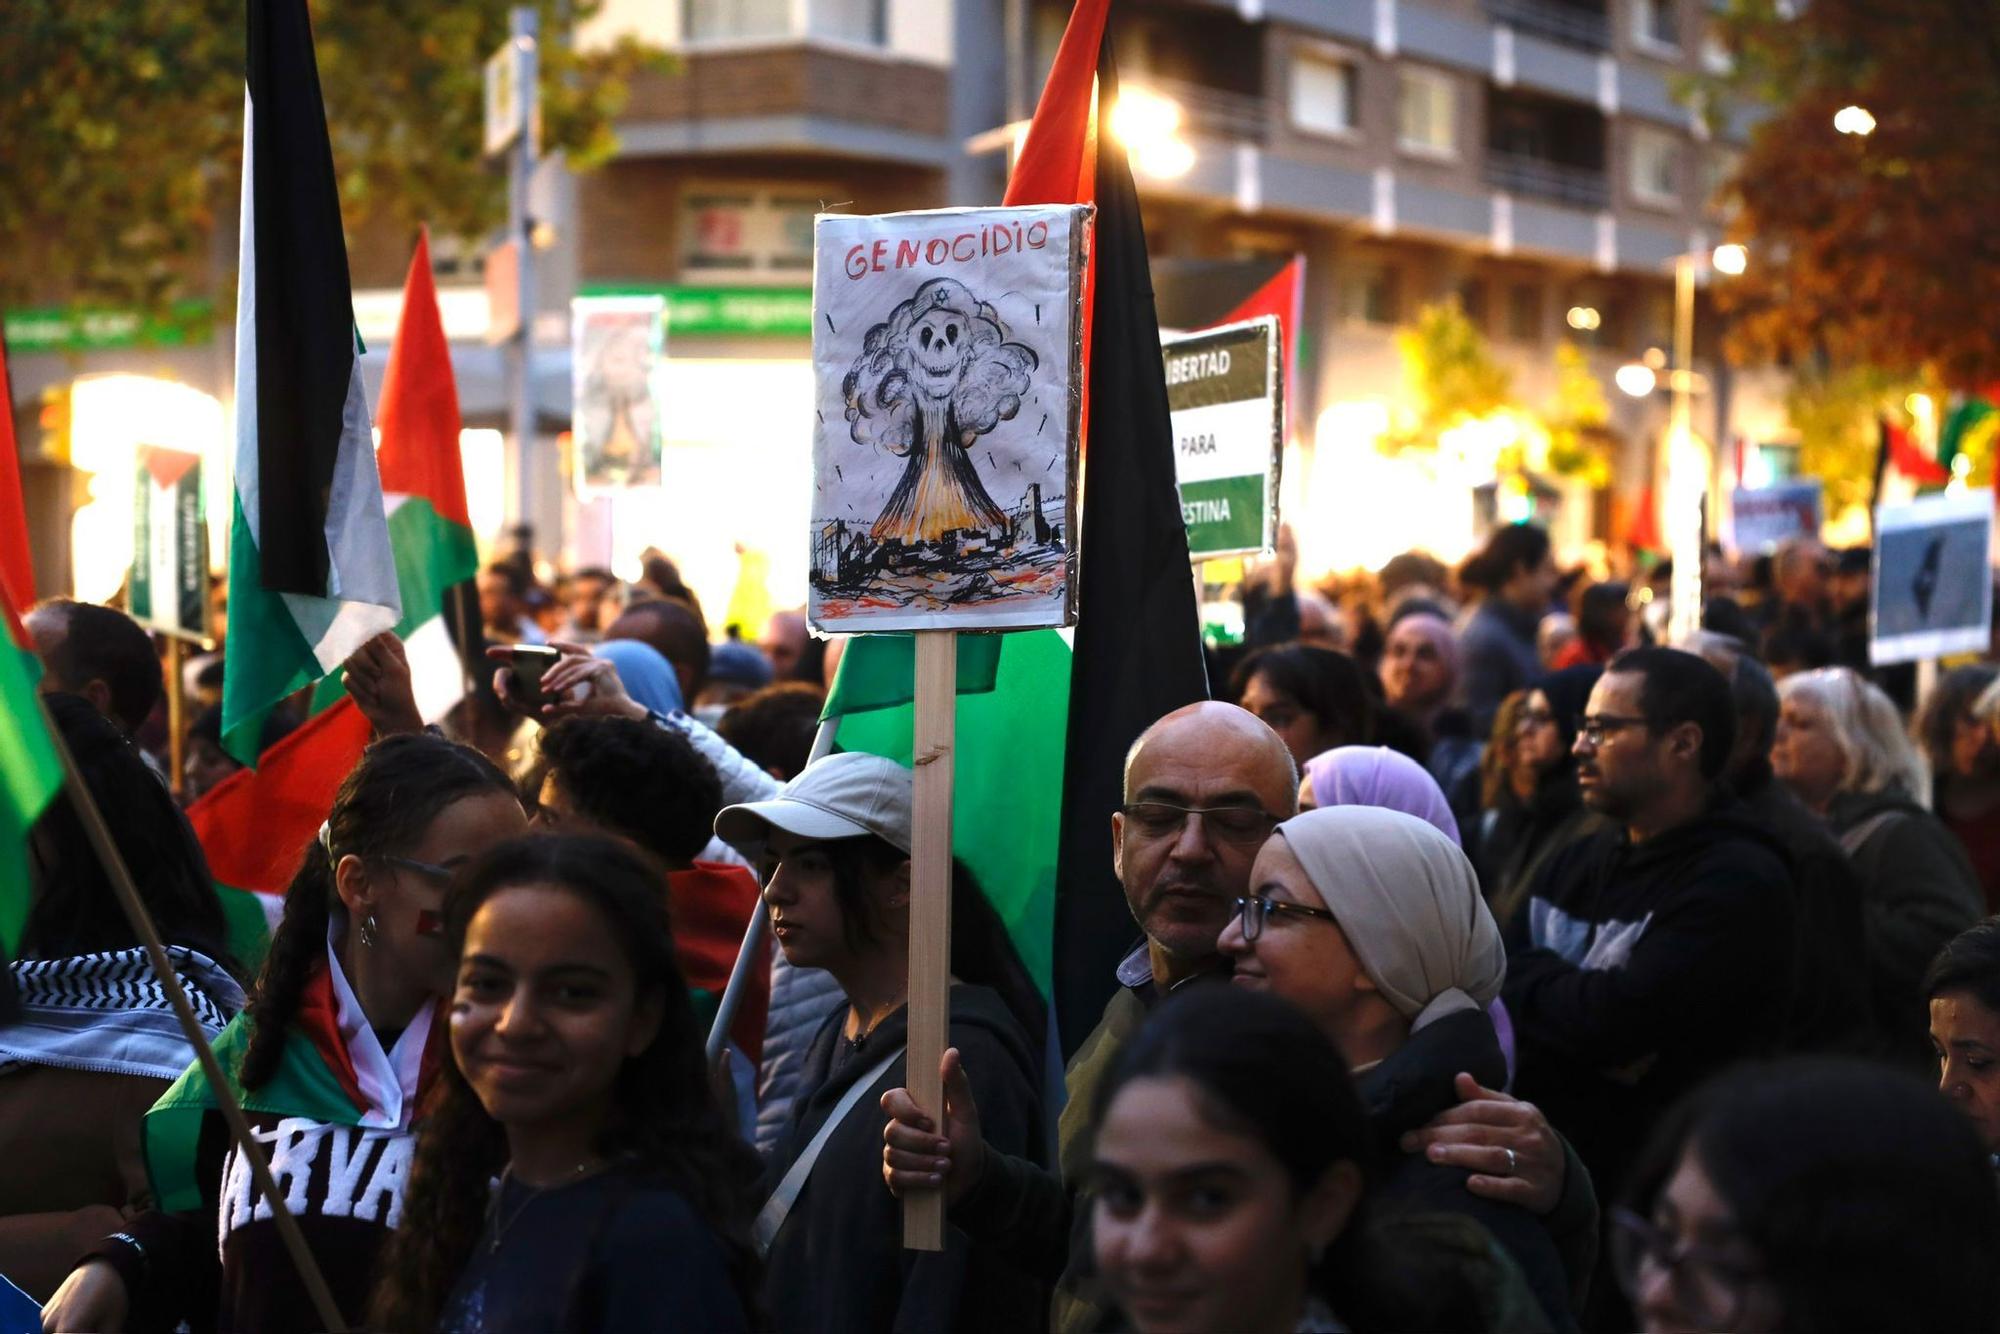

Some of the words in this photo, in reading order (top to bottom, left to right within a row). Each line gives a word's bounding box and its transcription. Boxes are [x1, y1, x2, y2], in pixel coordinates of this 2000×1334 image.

[1166, 350, 1231, 385] IBERTAD
[1181, 433, 1216, 457] PARA
[1183, 498, 1231, 524] ESTINA
[219, 1117, 416, 1264] ARVA
